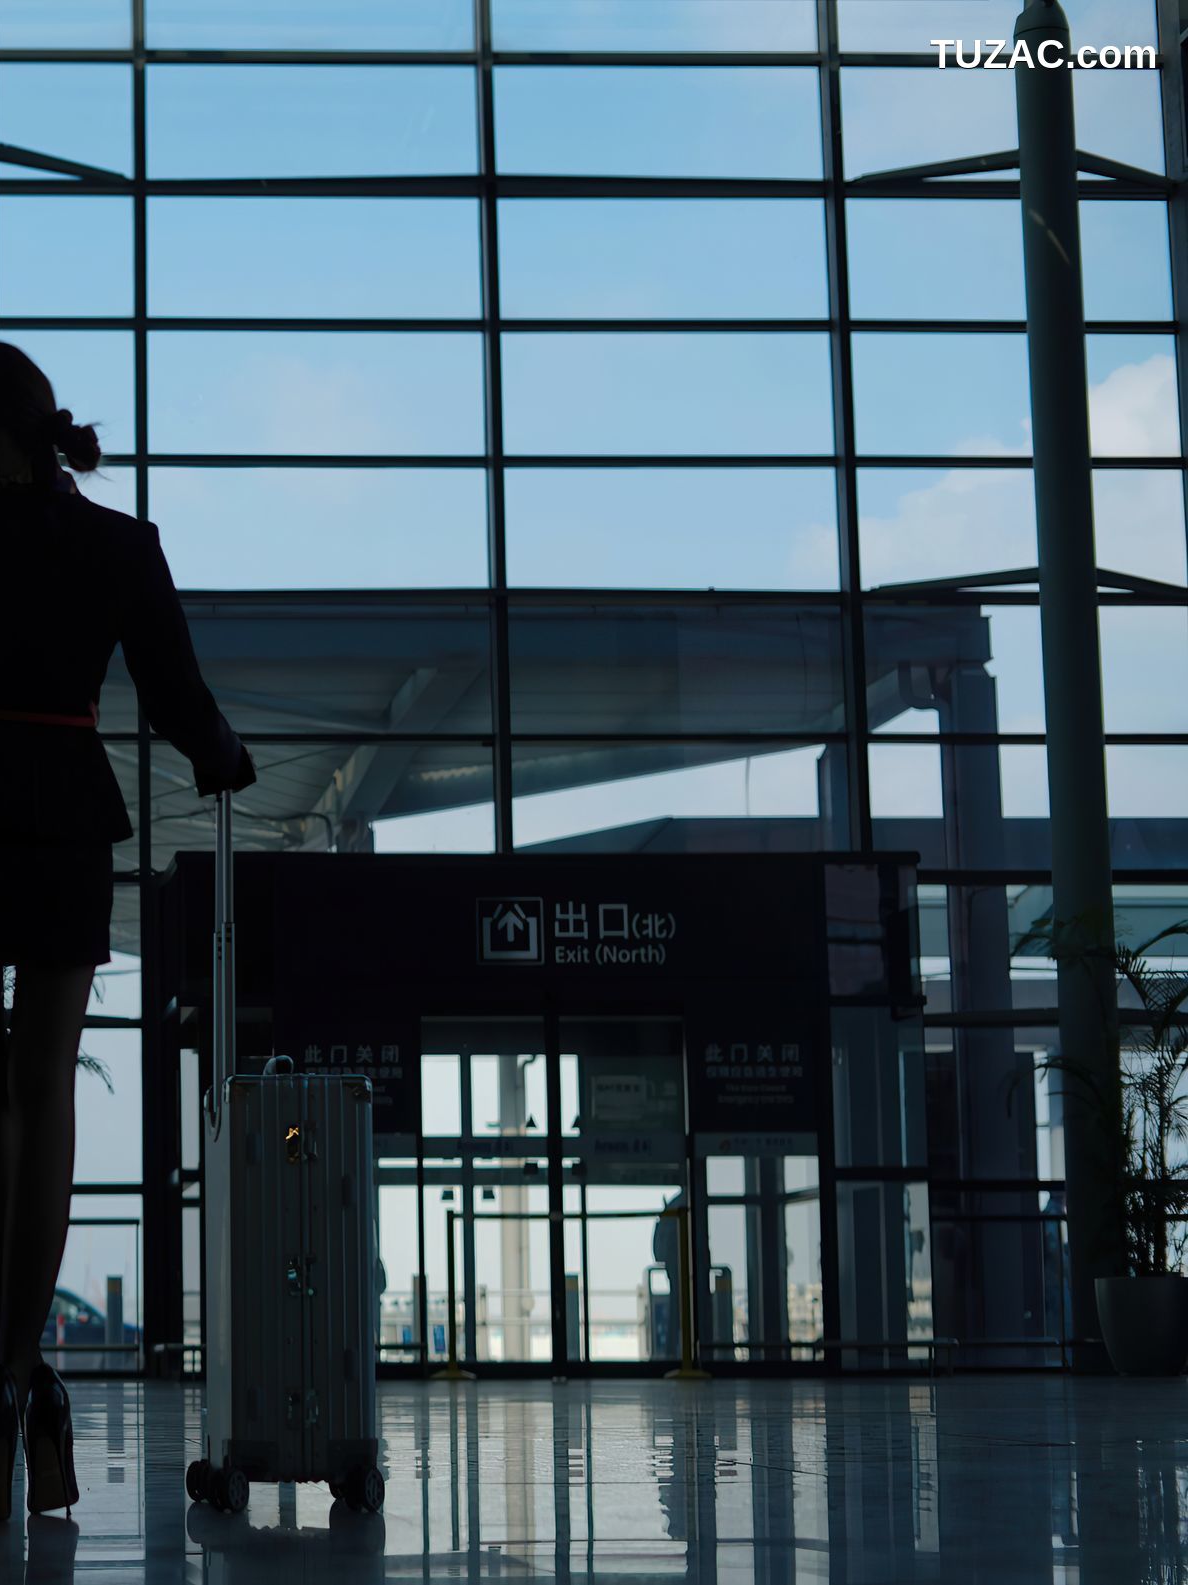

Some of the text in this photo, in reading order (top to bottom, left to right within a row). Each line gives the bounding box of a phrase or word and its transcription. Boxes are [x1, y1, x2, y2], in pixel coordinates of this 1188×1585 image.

[554, 901, 676, 940] 出口(北)
[555, 942, 667, 967] Exit (North)
[304, 1044, 400, 1064] 此门关闭
